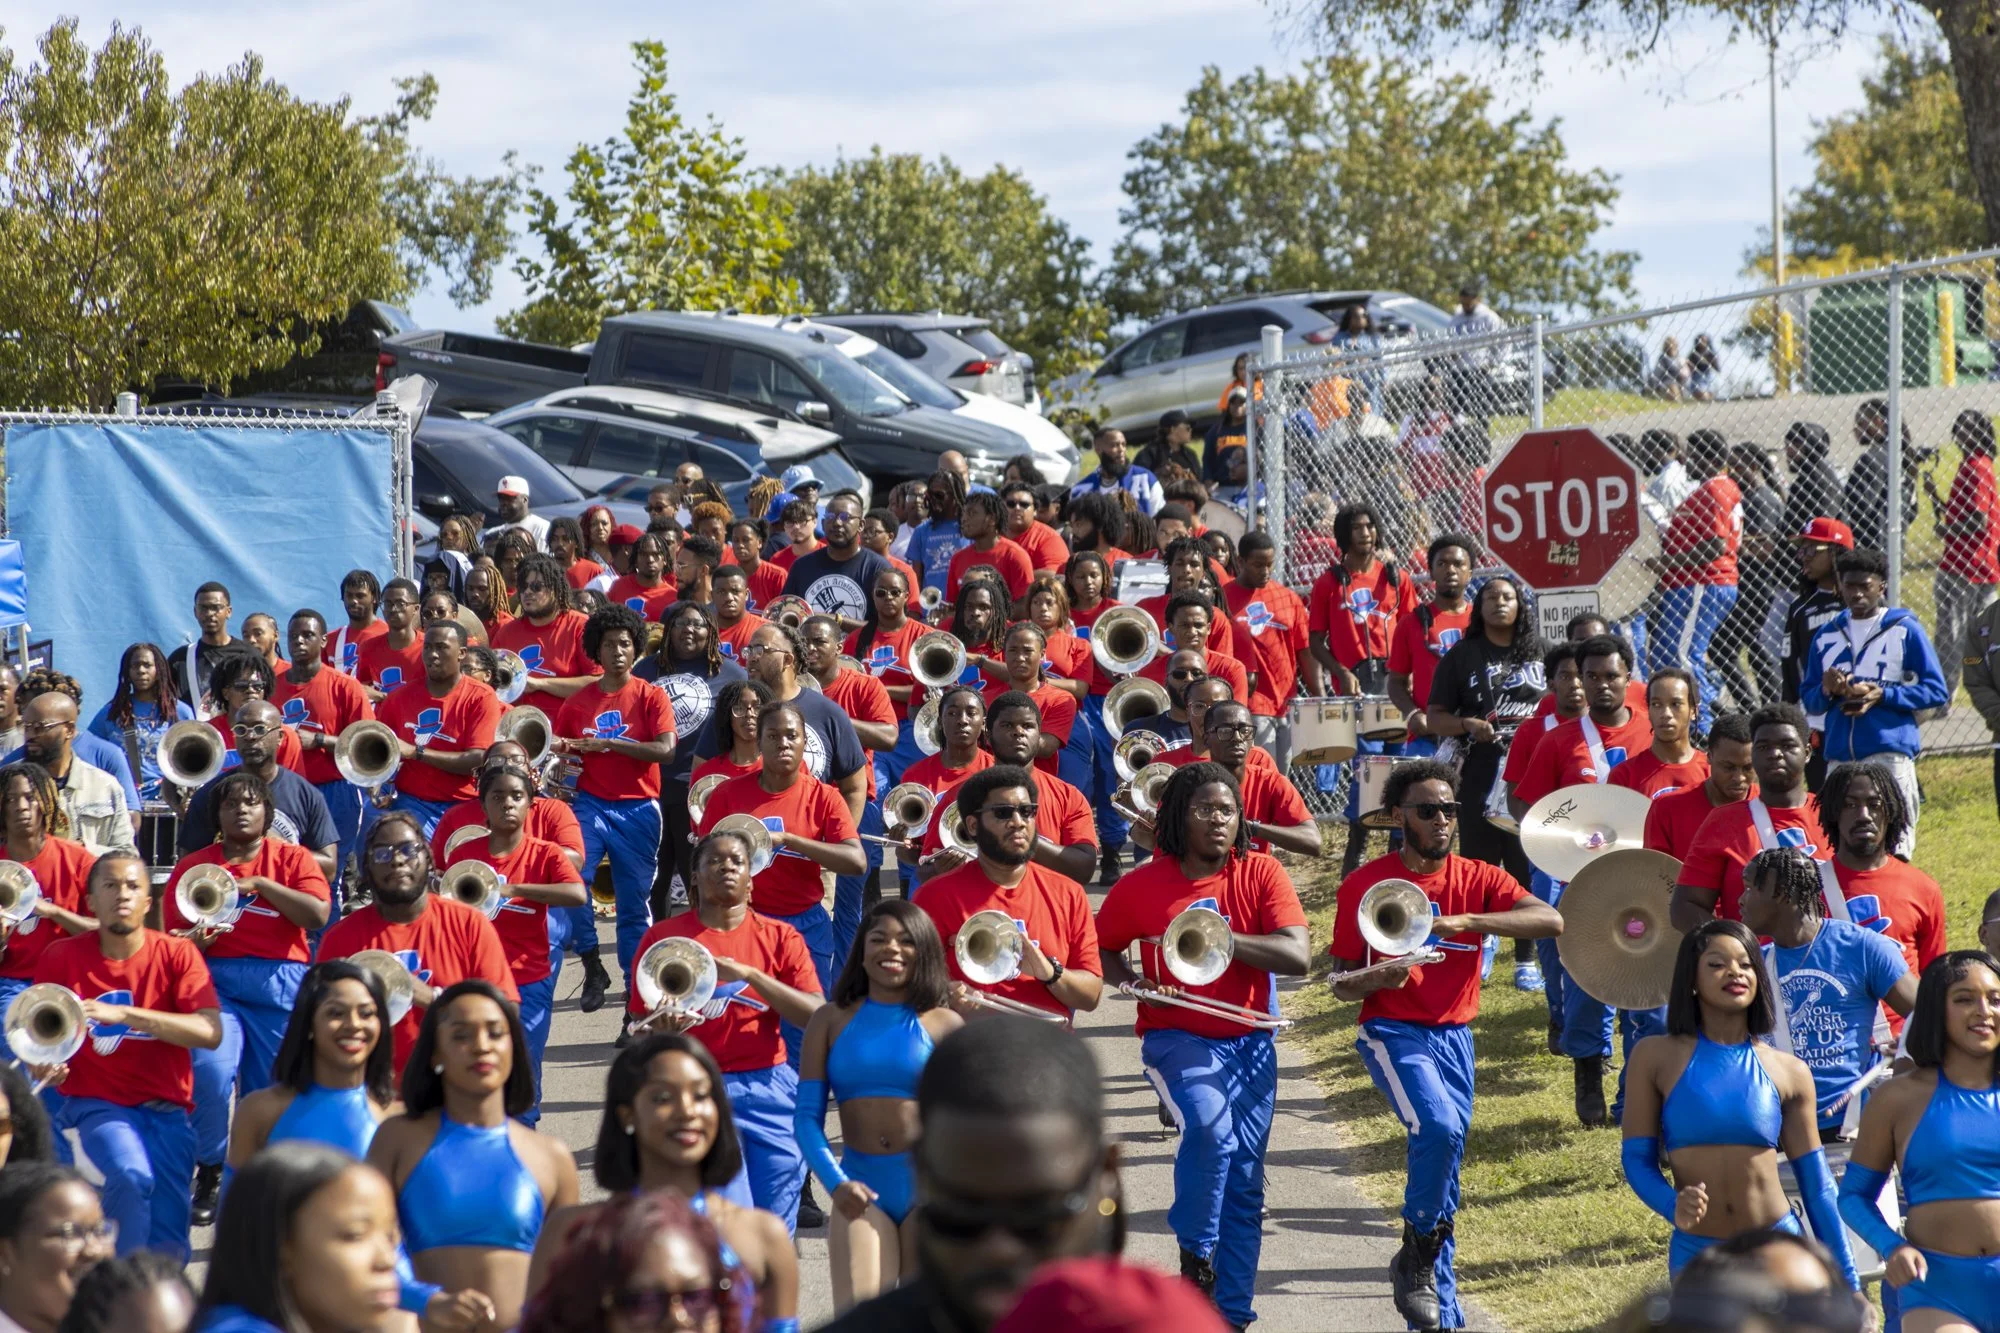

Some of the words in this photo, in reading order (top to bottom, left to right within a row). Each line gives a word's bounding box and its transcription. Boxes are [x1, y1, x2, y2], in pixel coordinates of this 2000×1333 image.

[1492, 476, 1629, 543] STOP
[1543, 607, 1559, 622] NO
[1543, 625, 1568, 640] TUR
[1781, 976, 1829, 994] RISTOCRAT
[1805, 1005, 1831, 1016] YOU
[1803, 1012, 1842, 1028] WISH
[1817, 1029, 1845, 1045] US
